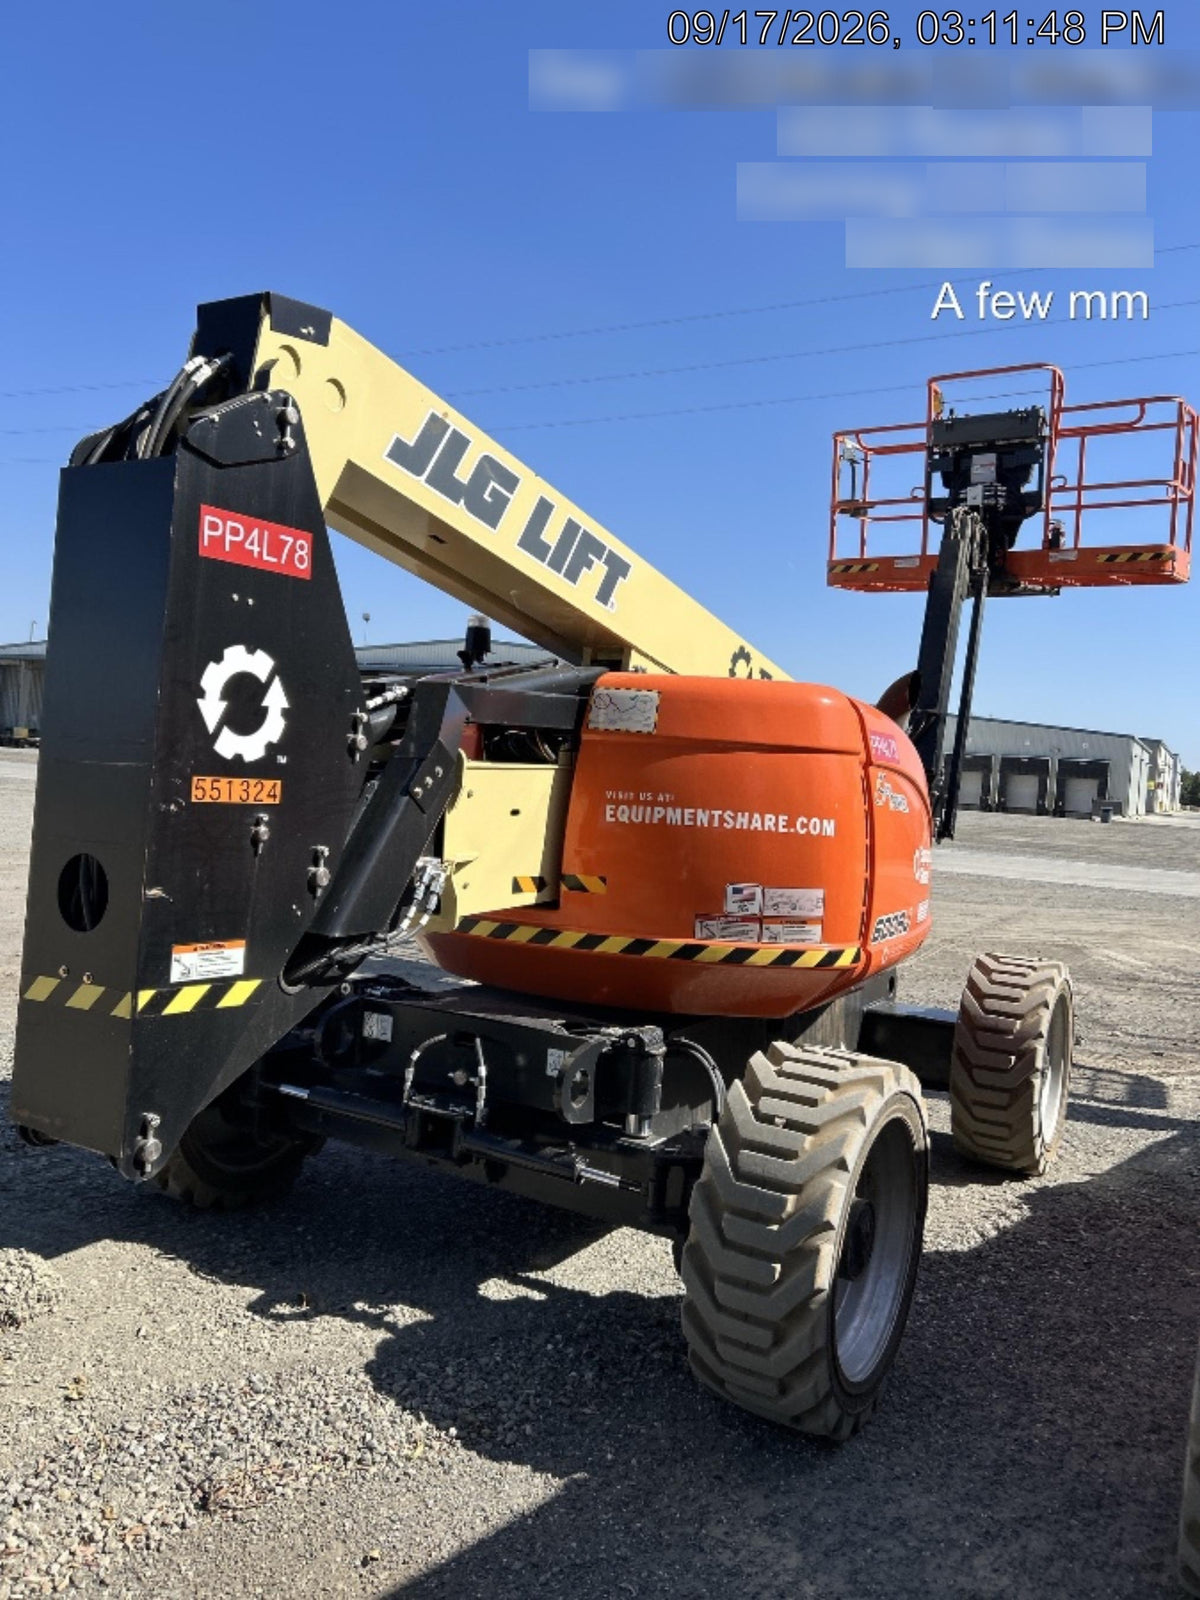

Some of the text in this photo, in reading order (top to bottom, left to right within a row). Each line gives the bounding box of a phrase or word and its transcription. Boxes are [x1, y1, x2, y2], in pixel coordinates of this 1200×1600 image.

[384, 409, 632, 609] JLG LIFT
[203, 514, 309, 570] PP4L78
[194, 778, 278, 803] 551324
[605, 790, 635, 801] VISIT
[639, 791, 654, 801] US
[605, 804, 836, 838] EQUIPMENTSHARE.COM
